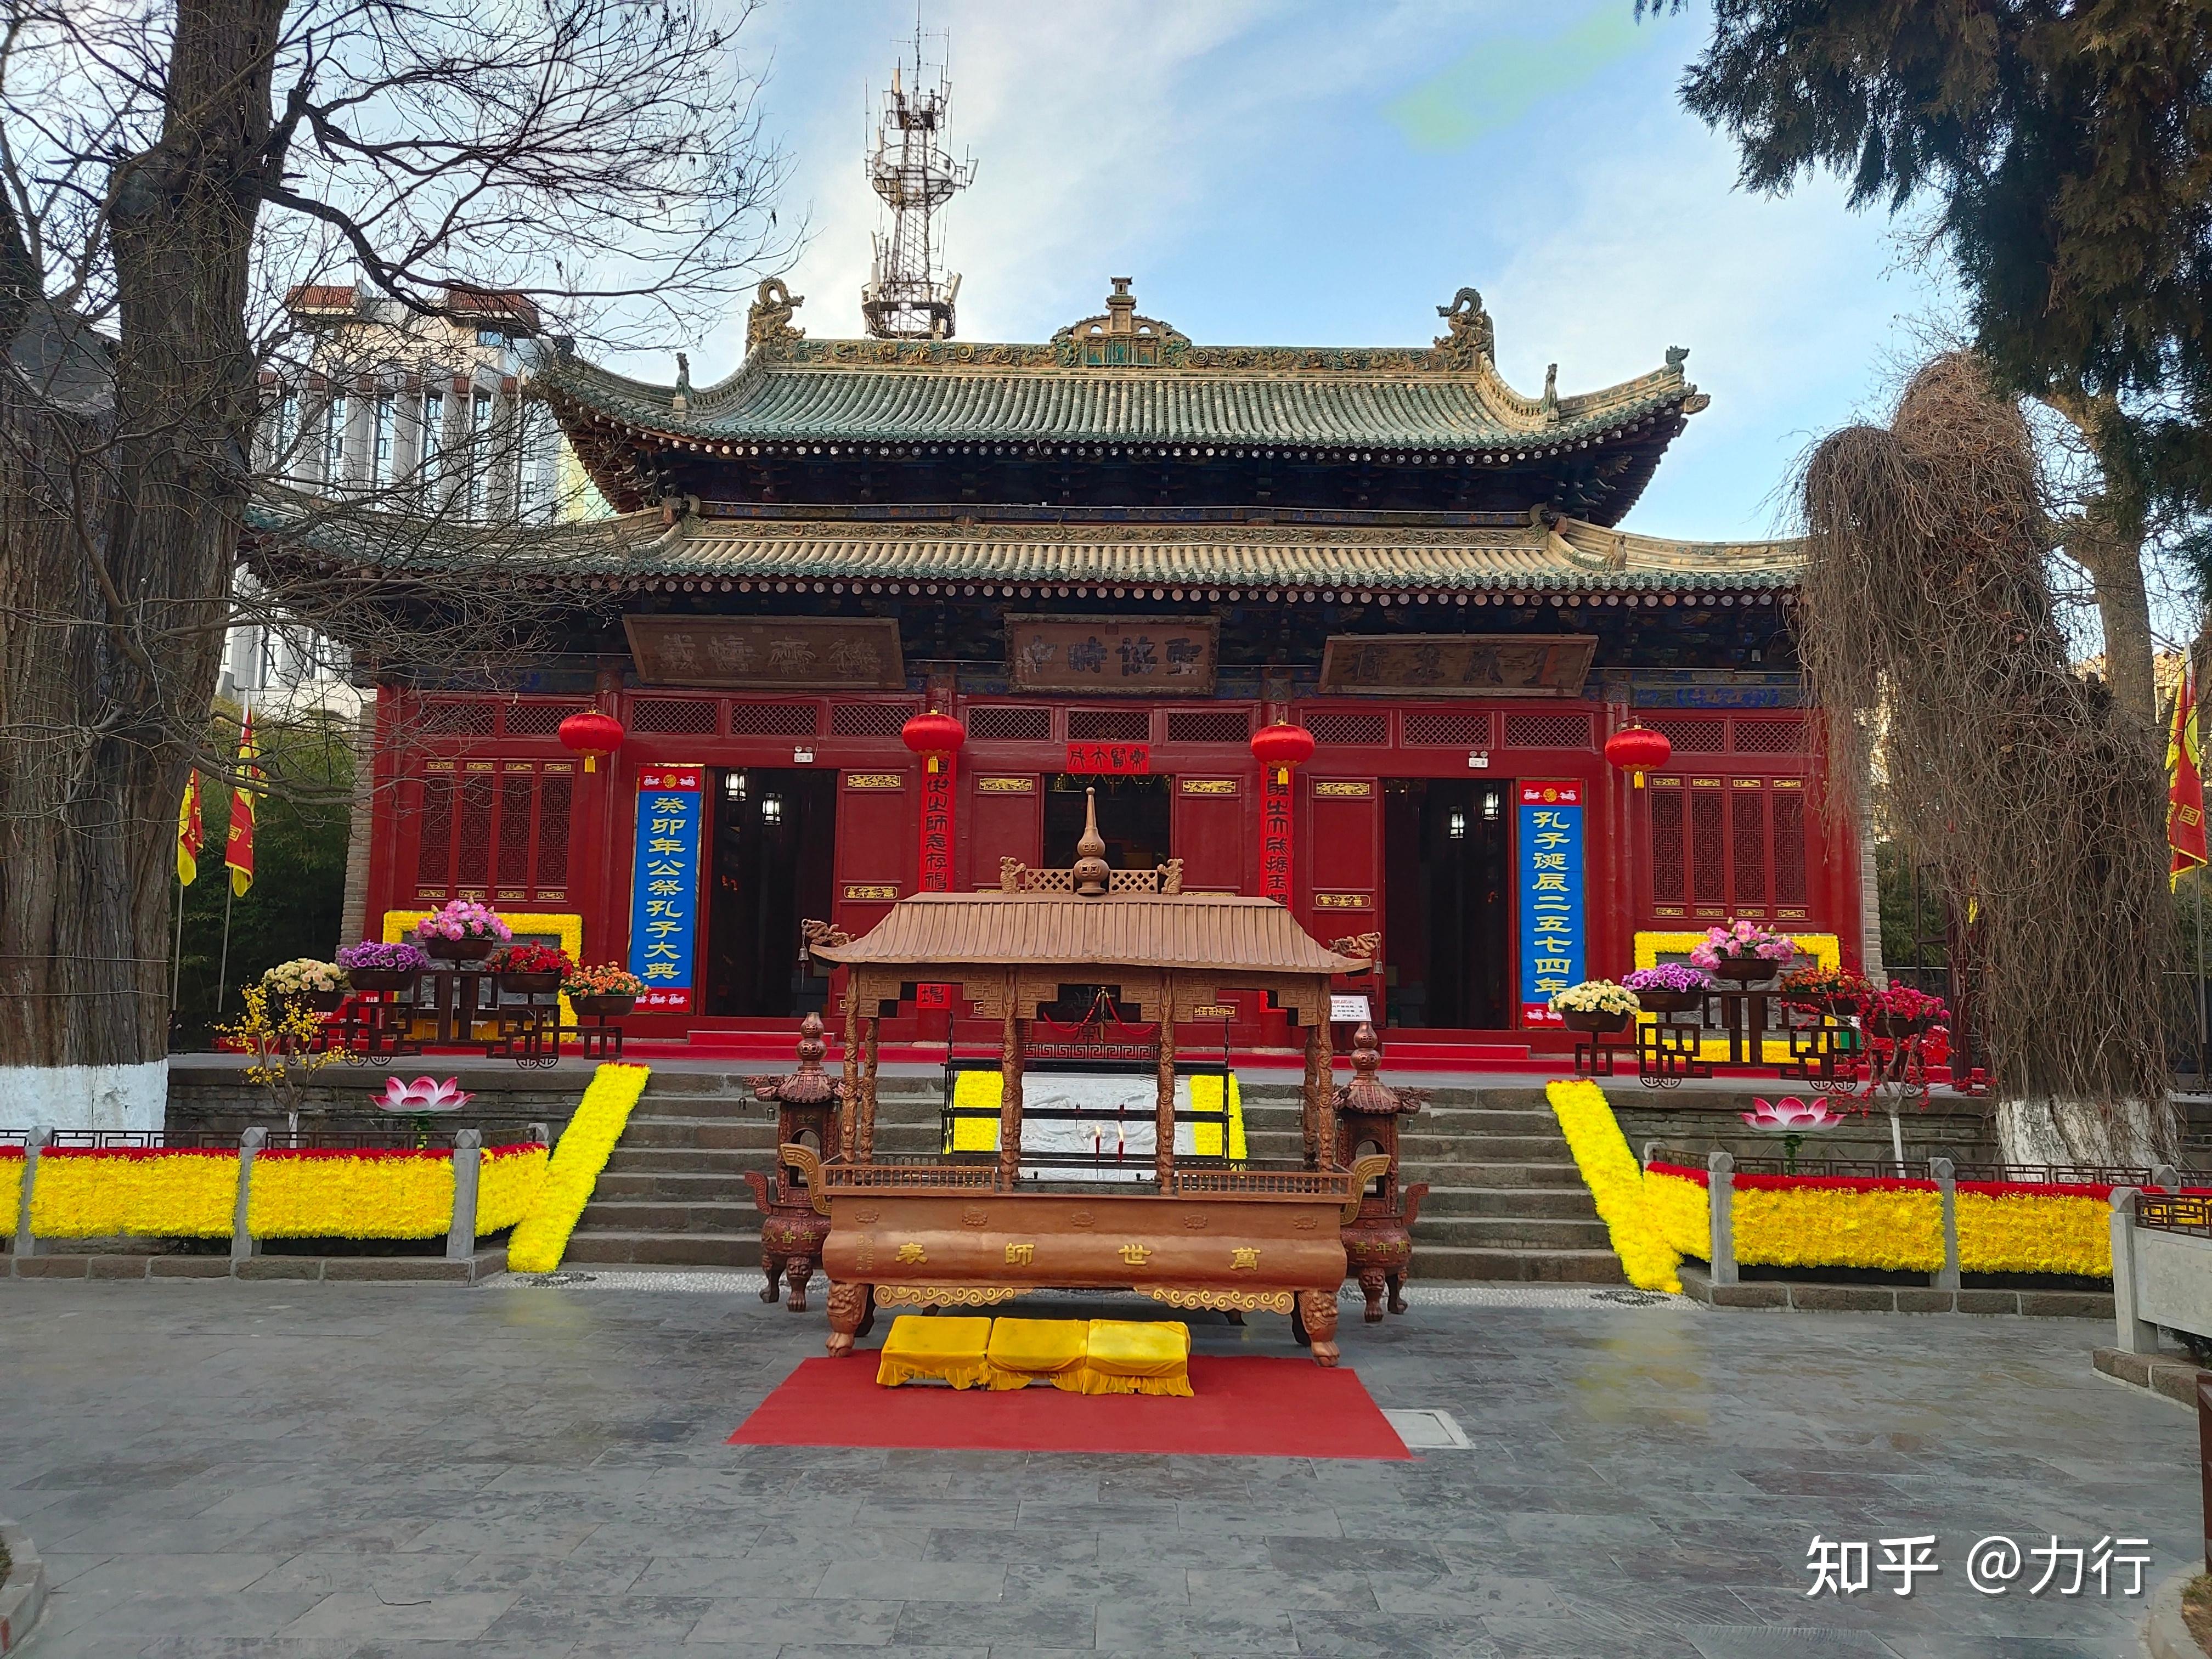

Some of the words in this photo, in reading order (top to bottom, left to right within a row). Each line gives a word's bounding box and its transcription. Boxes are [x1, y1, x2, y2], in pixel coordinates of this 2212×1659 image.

[642, 797, 688, 980] 癸卯年公祭孔子大典
[1532, 811, 1573, 996] 孔子诞辰二五七四年
[895, 1242, 1261, 1271] 萬世師表
[1344, 1240, 1410, 1255] 萬年香
